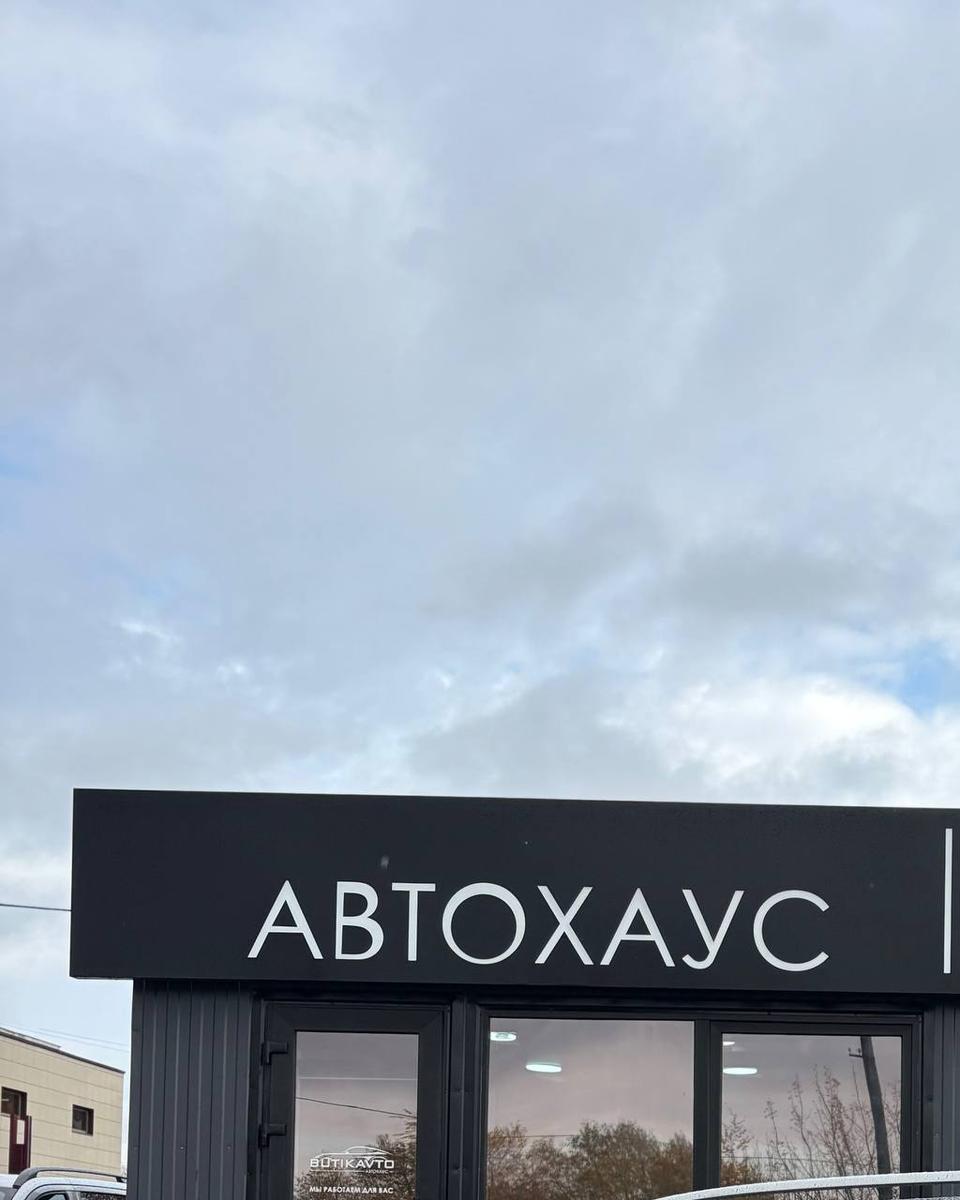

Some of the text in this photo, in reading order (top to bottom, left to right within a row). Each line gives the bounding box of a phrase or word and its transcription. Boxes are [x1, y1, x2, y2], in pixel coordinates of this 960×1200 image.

[247, 880, 830, 972] АВТОХАУС
[309, 1158, 395, 1169] BUTIKAVTO
[323, 1186, 361, 1194] РАБОТАЕМ
